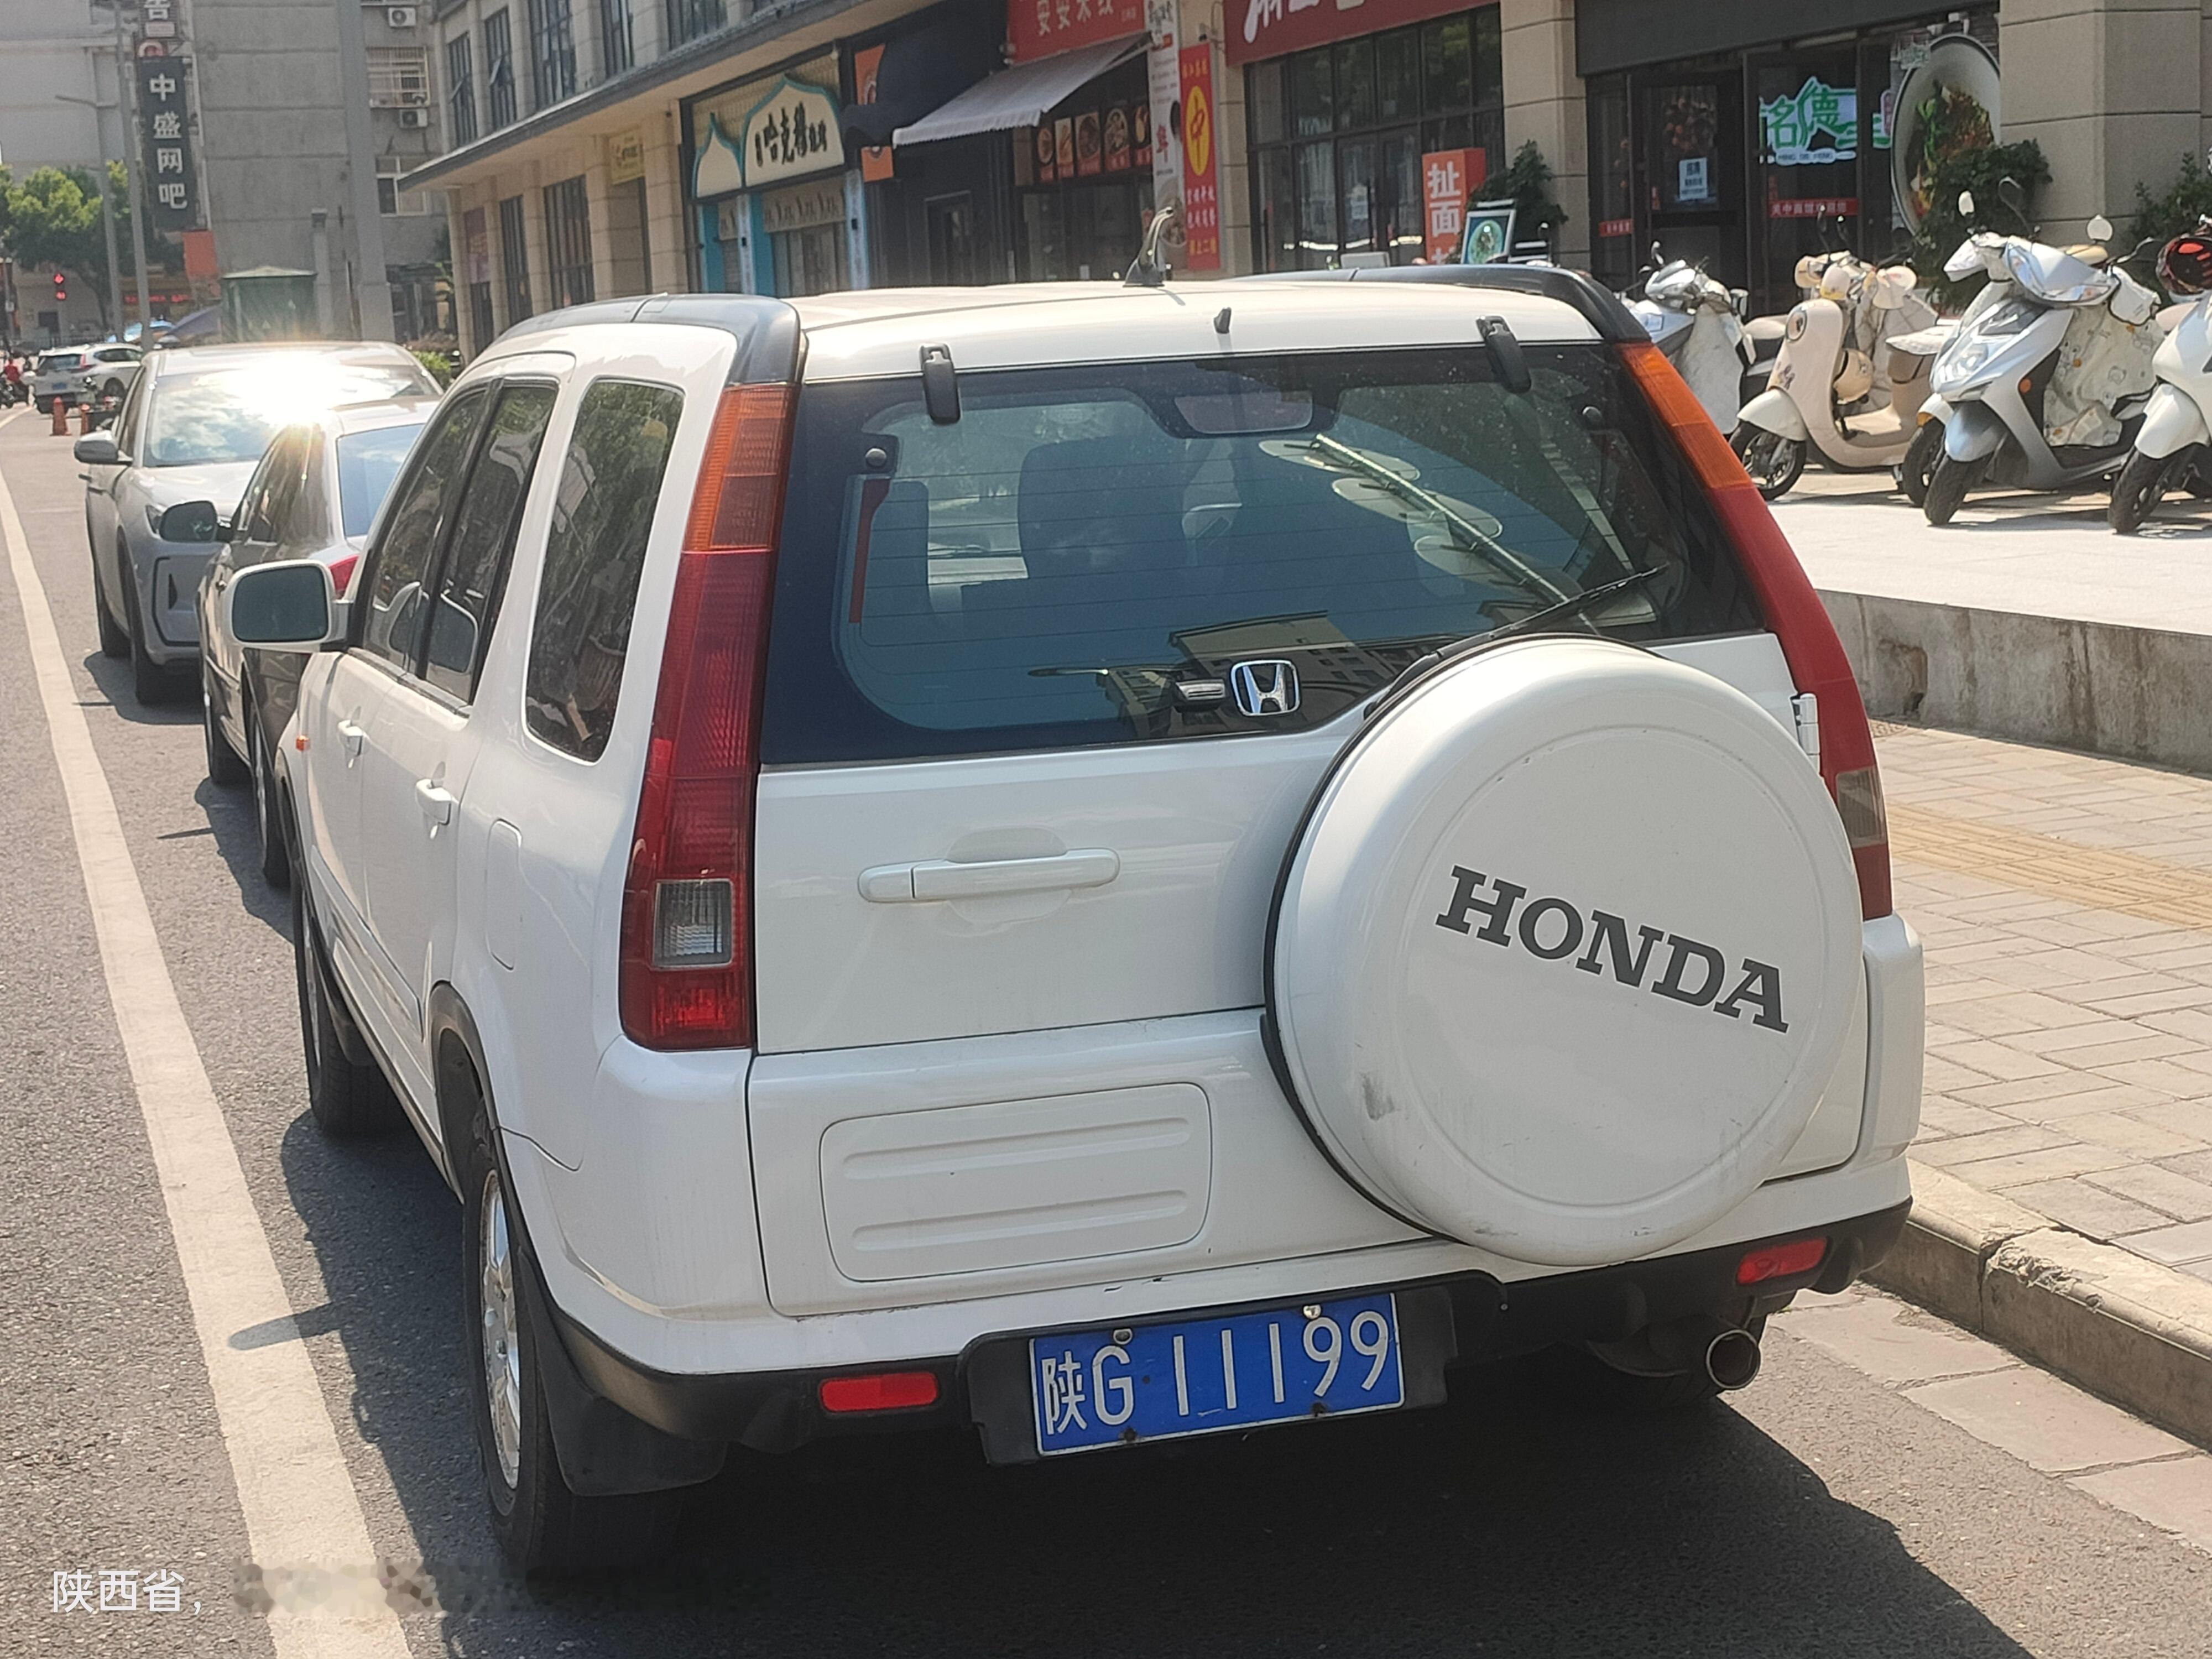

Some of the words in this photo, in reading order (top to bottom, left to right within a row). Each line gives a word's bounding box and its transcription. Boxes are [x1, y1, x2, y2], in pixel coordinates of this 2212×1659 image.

[149, 72, 187, 210] 中盛网吧
[1427, 160, 1462, 264] 扯面
[1436, 864, 1789, 1034] HONDA
